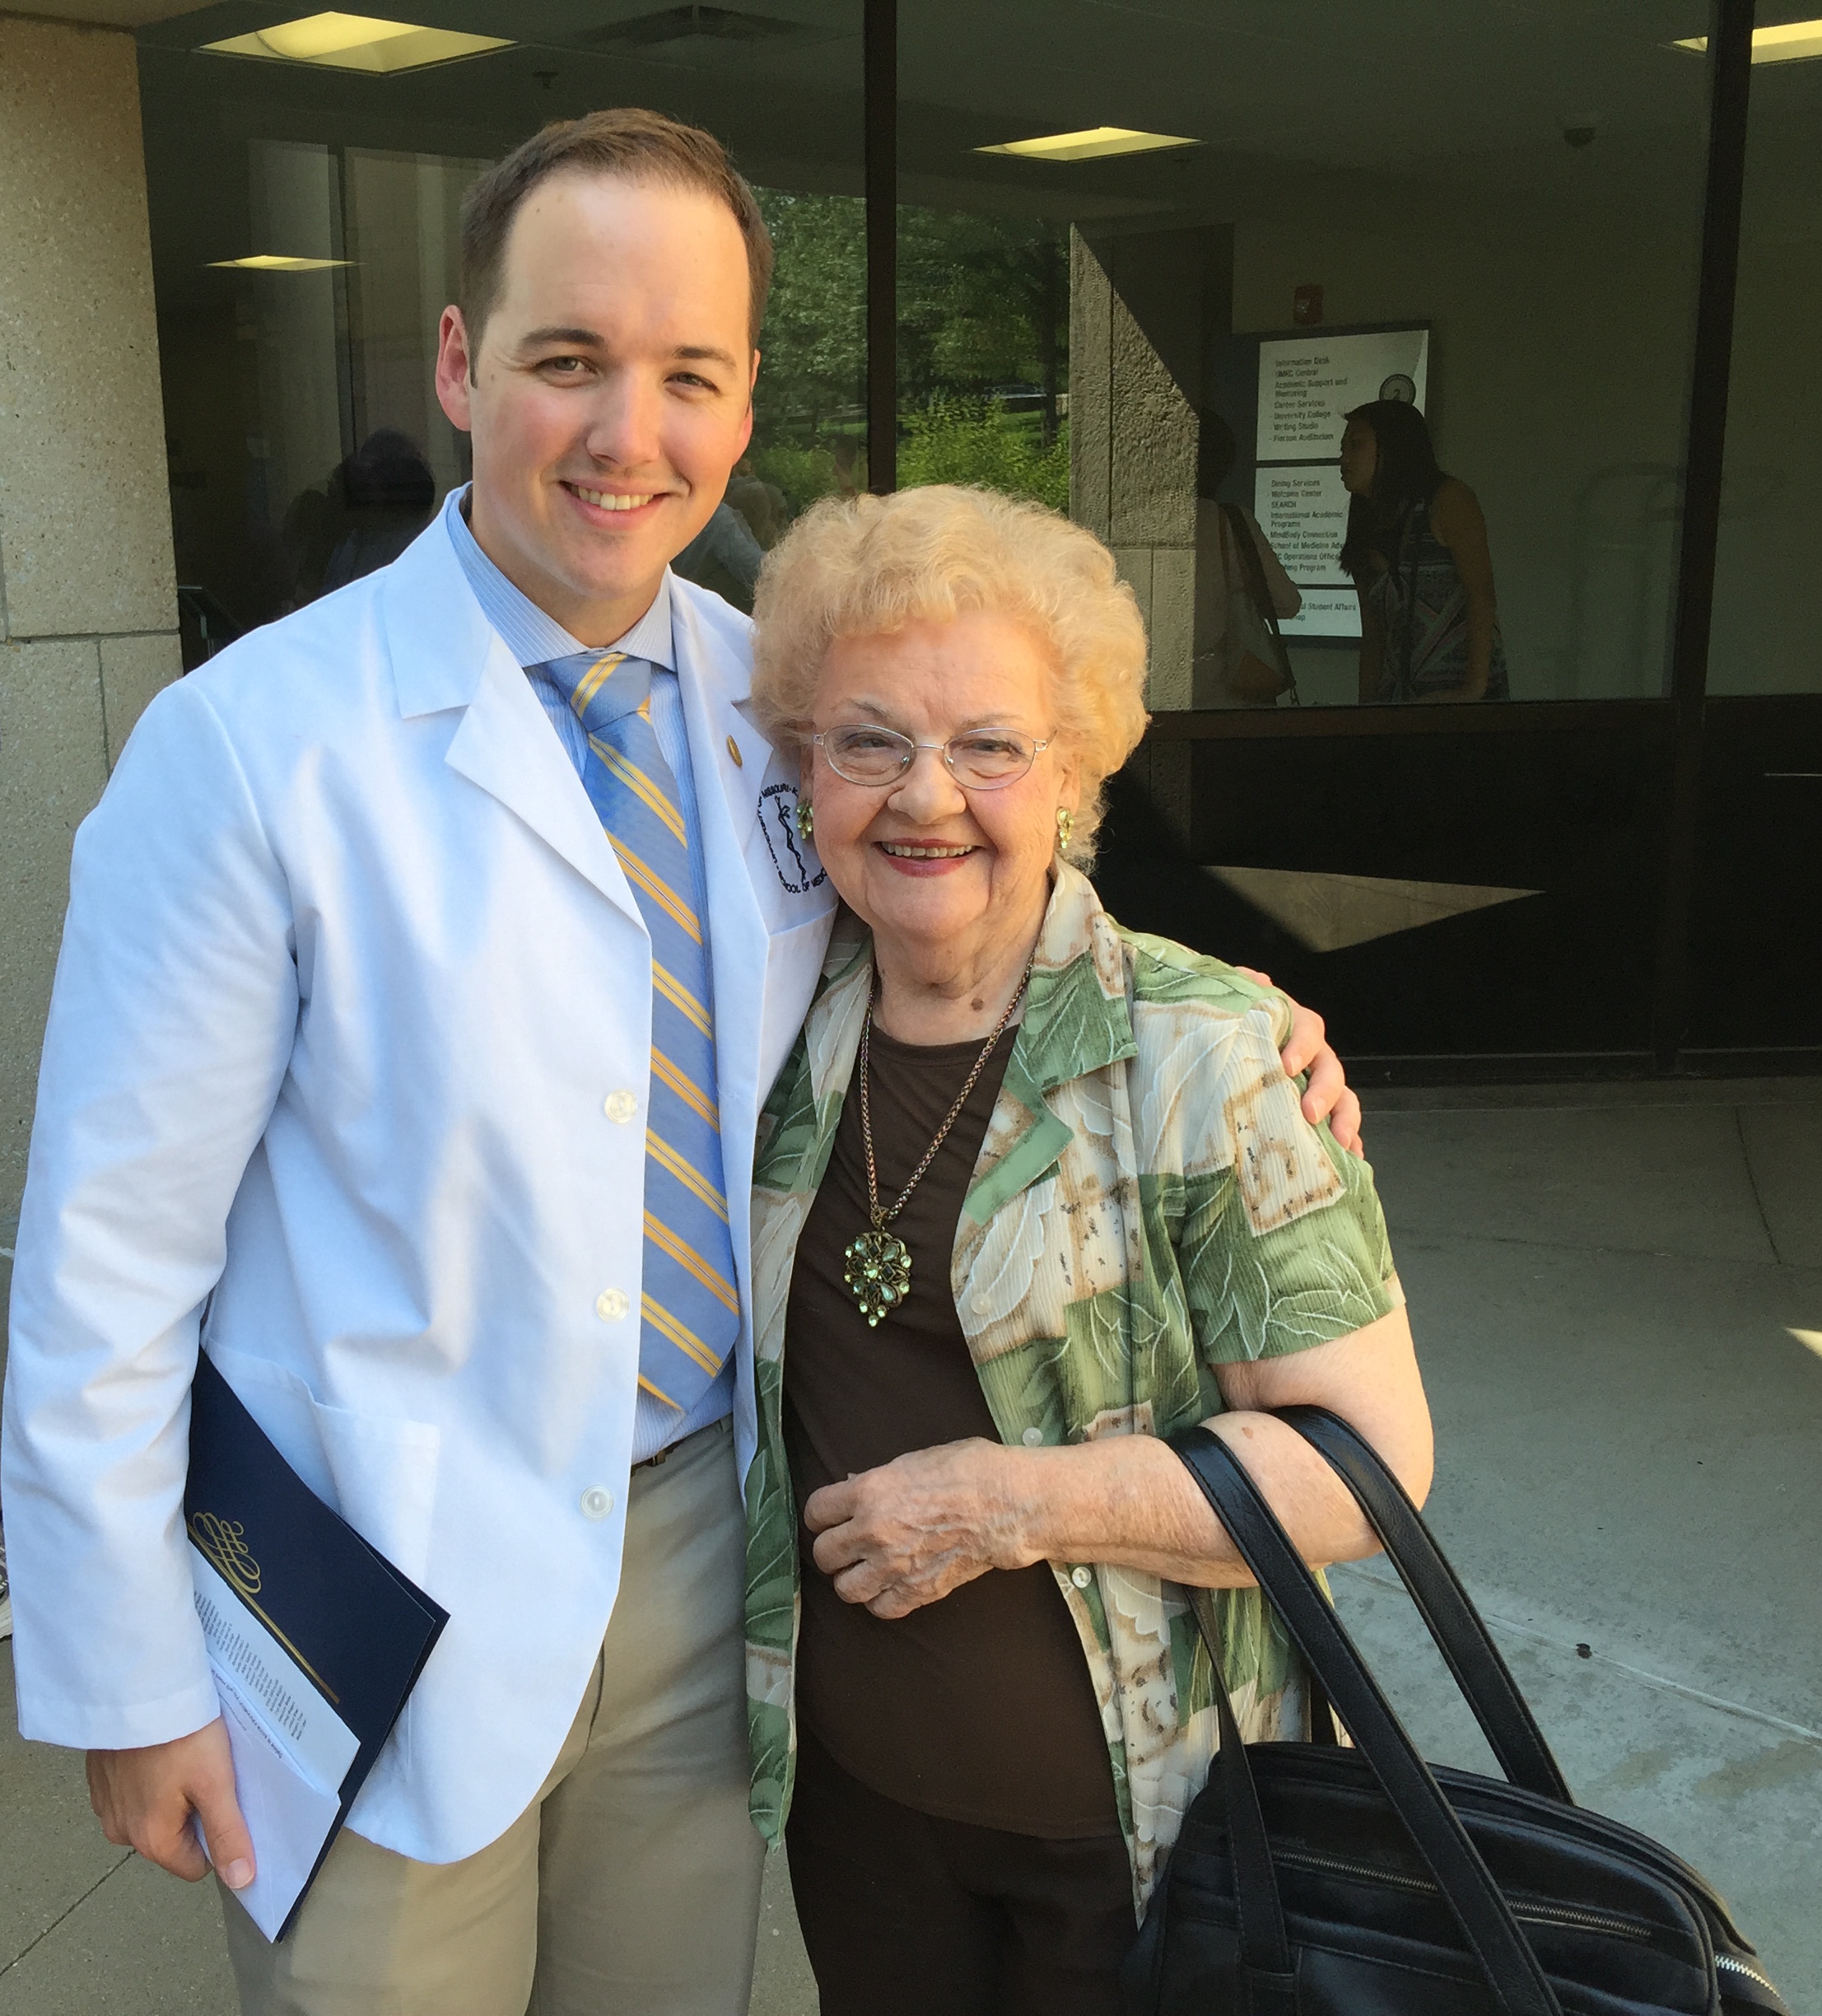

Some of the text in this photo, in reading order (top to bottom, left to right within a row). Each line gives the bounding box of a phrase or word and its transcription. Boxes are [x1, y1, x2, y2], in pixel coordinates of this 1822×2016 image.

[1275, 358, 1312, 367] Information
[1295, 369, 1318, 377] Central
[1274, 378, 1348, 389] Academic Support and
[1274, 390, 1307, 399] Mentoring
[1274, 399, 1326, 409] Career Services
[1307, 411, 1331, 420] College
[1274, 422, 1319, 432] Writing Studio
[1298, 432, 1334, 441] Auditorium
[1271, 478, 1320, 488] Dining Services
[1271, 490, 1299, 498] Welcome
[1271, 501, 1297, 509] SEARCH
[1312, 511, 1344, 519] Academic
[1270, 520, 1301, 530] Programs
[1302, 530, 1339, 539] Connection
[1292, 542, 1300, 550] of
[1301, 541, 1330, 551] Medicine
[1284, 553, 1318, 562] Operations
[1299, 563, 1327, 574] Program
[1307, 602, 1333, 612] Student
[1334, 602, 1357, 612] Affairs
[801, 880, 811, 893] OF
